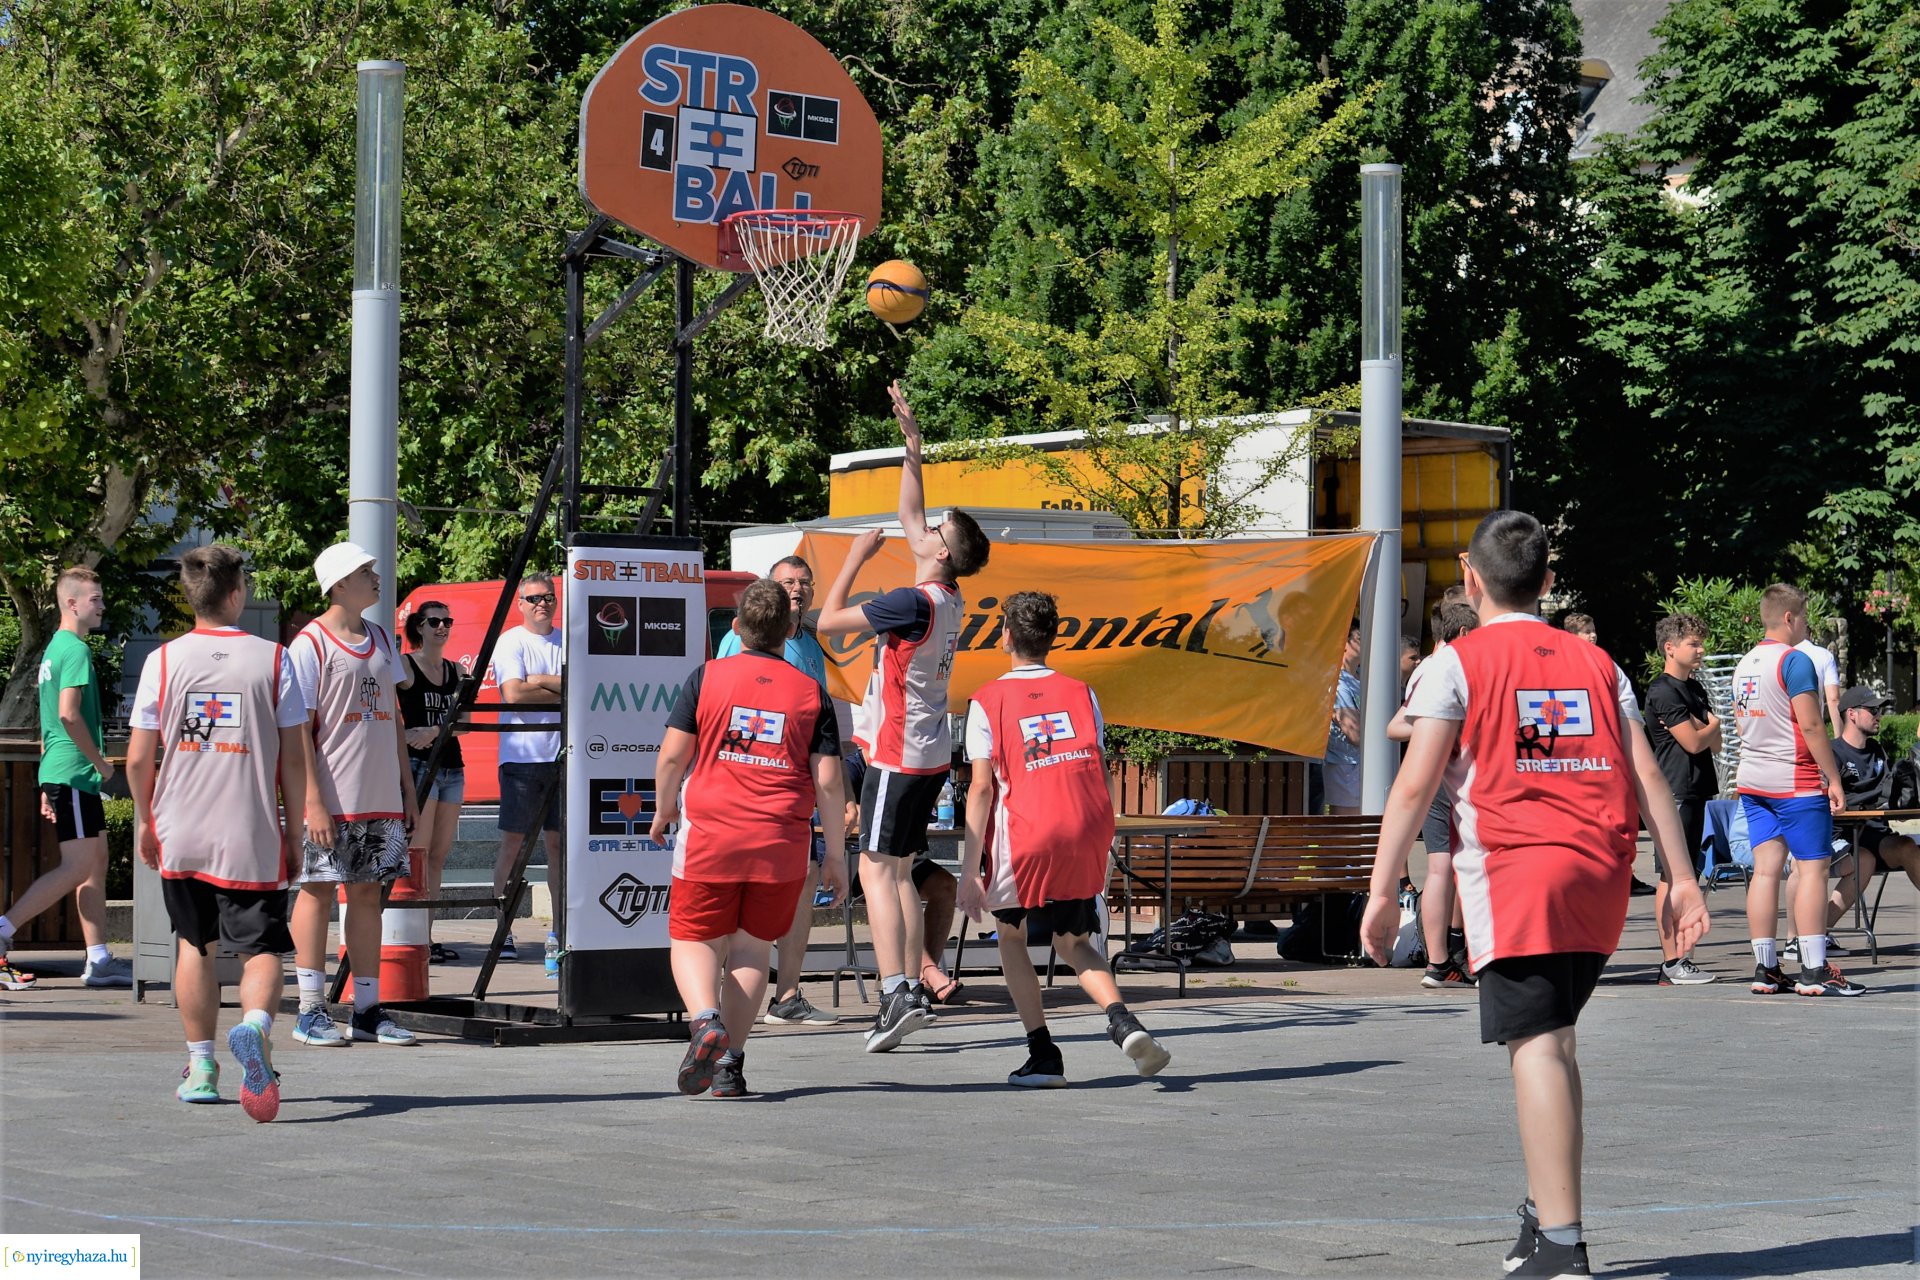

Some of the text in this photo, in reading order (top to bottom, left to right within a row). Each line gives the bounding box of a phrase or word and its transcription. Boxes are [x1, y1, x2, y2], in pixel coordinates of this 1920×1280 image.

[807, 114, 834, 124] MKOSZ
[650, 128, 665, 156] 4
[644, 622, 681, 631] MKOSZ
[589, 742, 605, 752] GB
[718, 750, 790, 769] STREETBALL
[1025, 748, 1092, 772] STREETBALL
[1515, 757, 1612, 773] STREETBALL
